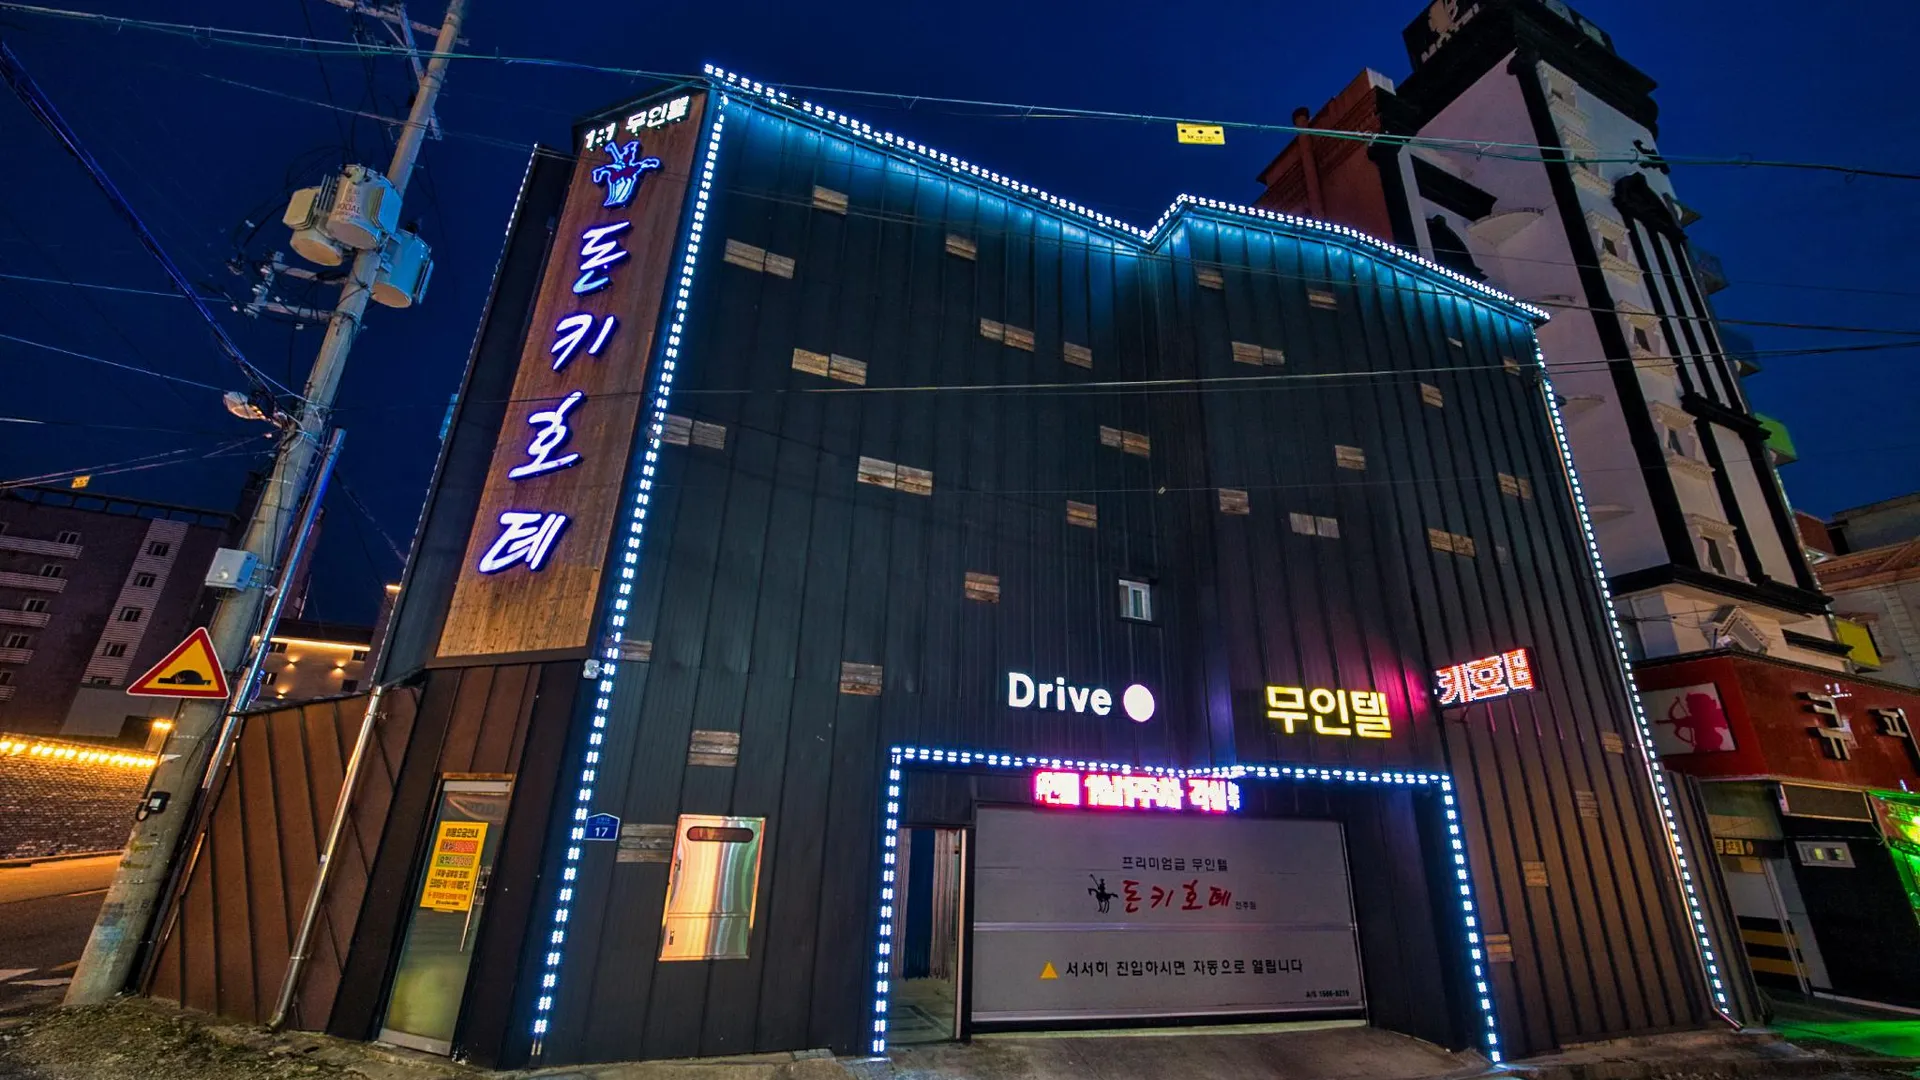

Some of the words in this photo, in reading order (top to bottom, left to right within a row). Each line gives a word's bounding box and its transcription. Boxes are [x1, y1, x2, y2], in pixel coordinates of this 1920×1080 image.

[585, 122, 616, 149] 1:1
[478, 221, 631, 574] 돈키호테
[1008, 672, 1112, 716] Drive
[1266, 685, 1393, 739] 무인텔
[594, 827, 609, 837] 17
[1121, 856, 1186, 872] 프리미엄급
[1192, 858, 1229, 872] 무인텔
[1122, 879, 1232, 914] 돈키호테
[1066, 960, 1109, 977] 서서히
[1116, 960, 1186, 976] 진입하시면
[1193, 960, 1246, 976] 자동으로
[1252, 959, 1304, 975] 열립니다
